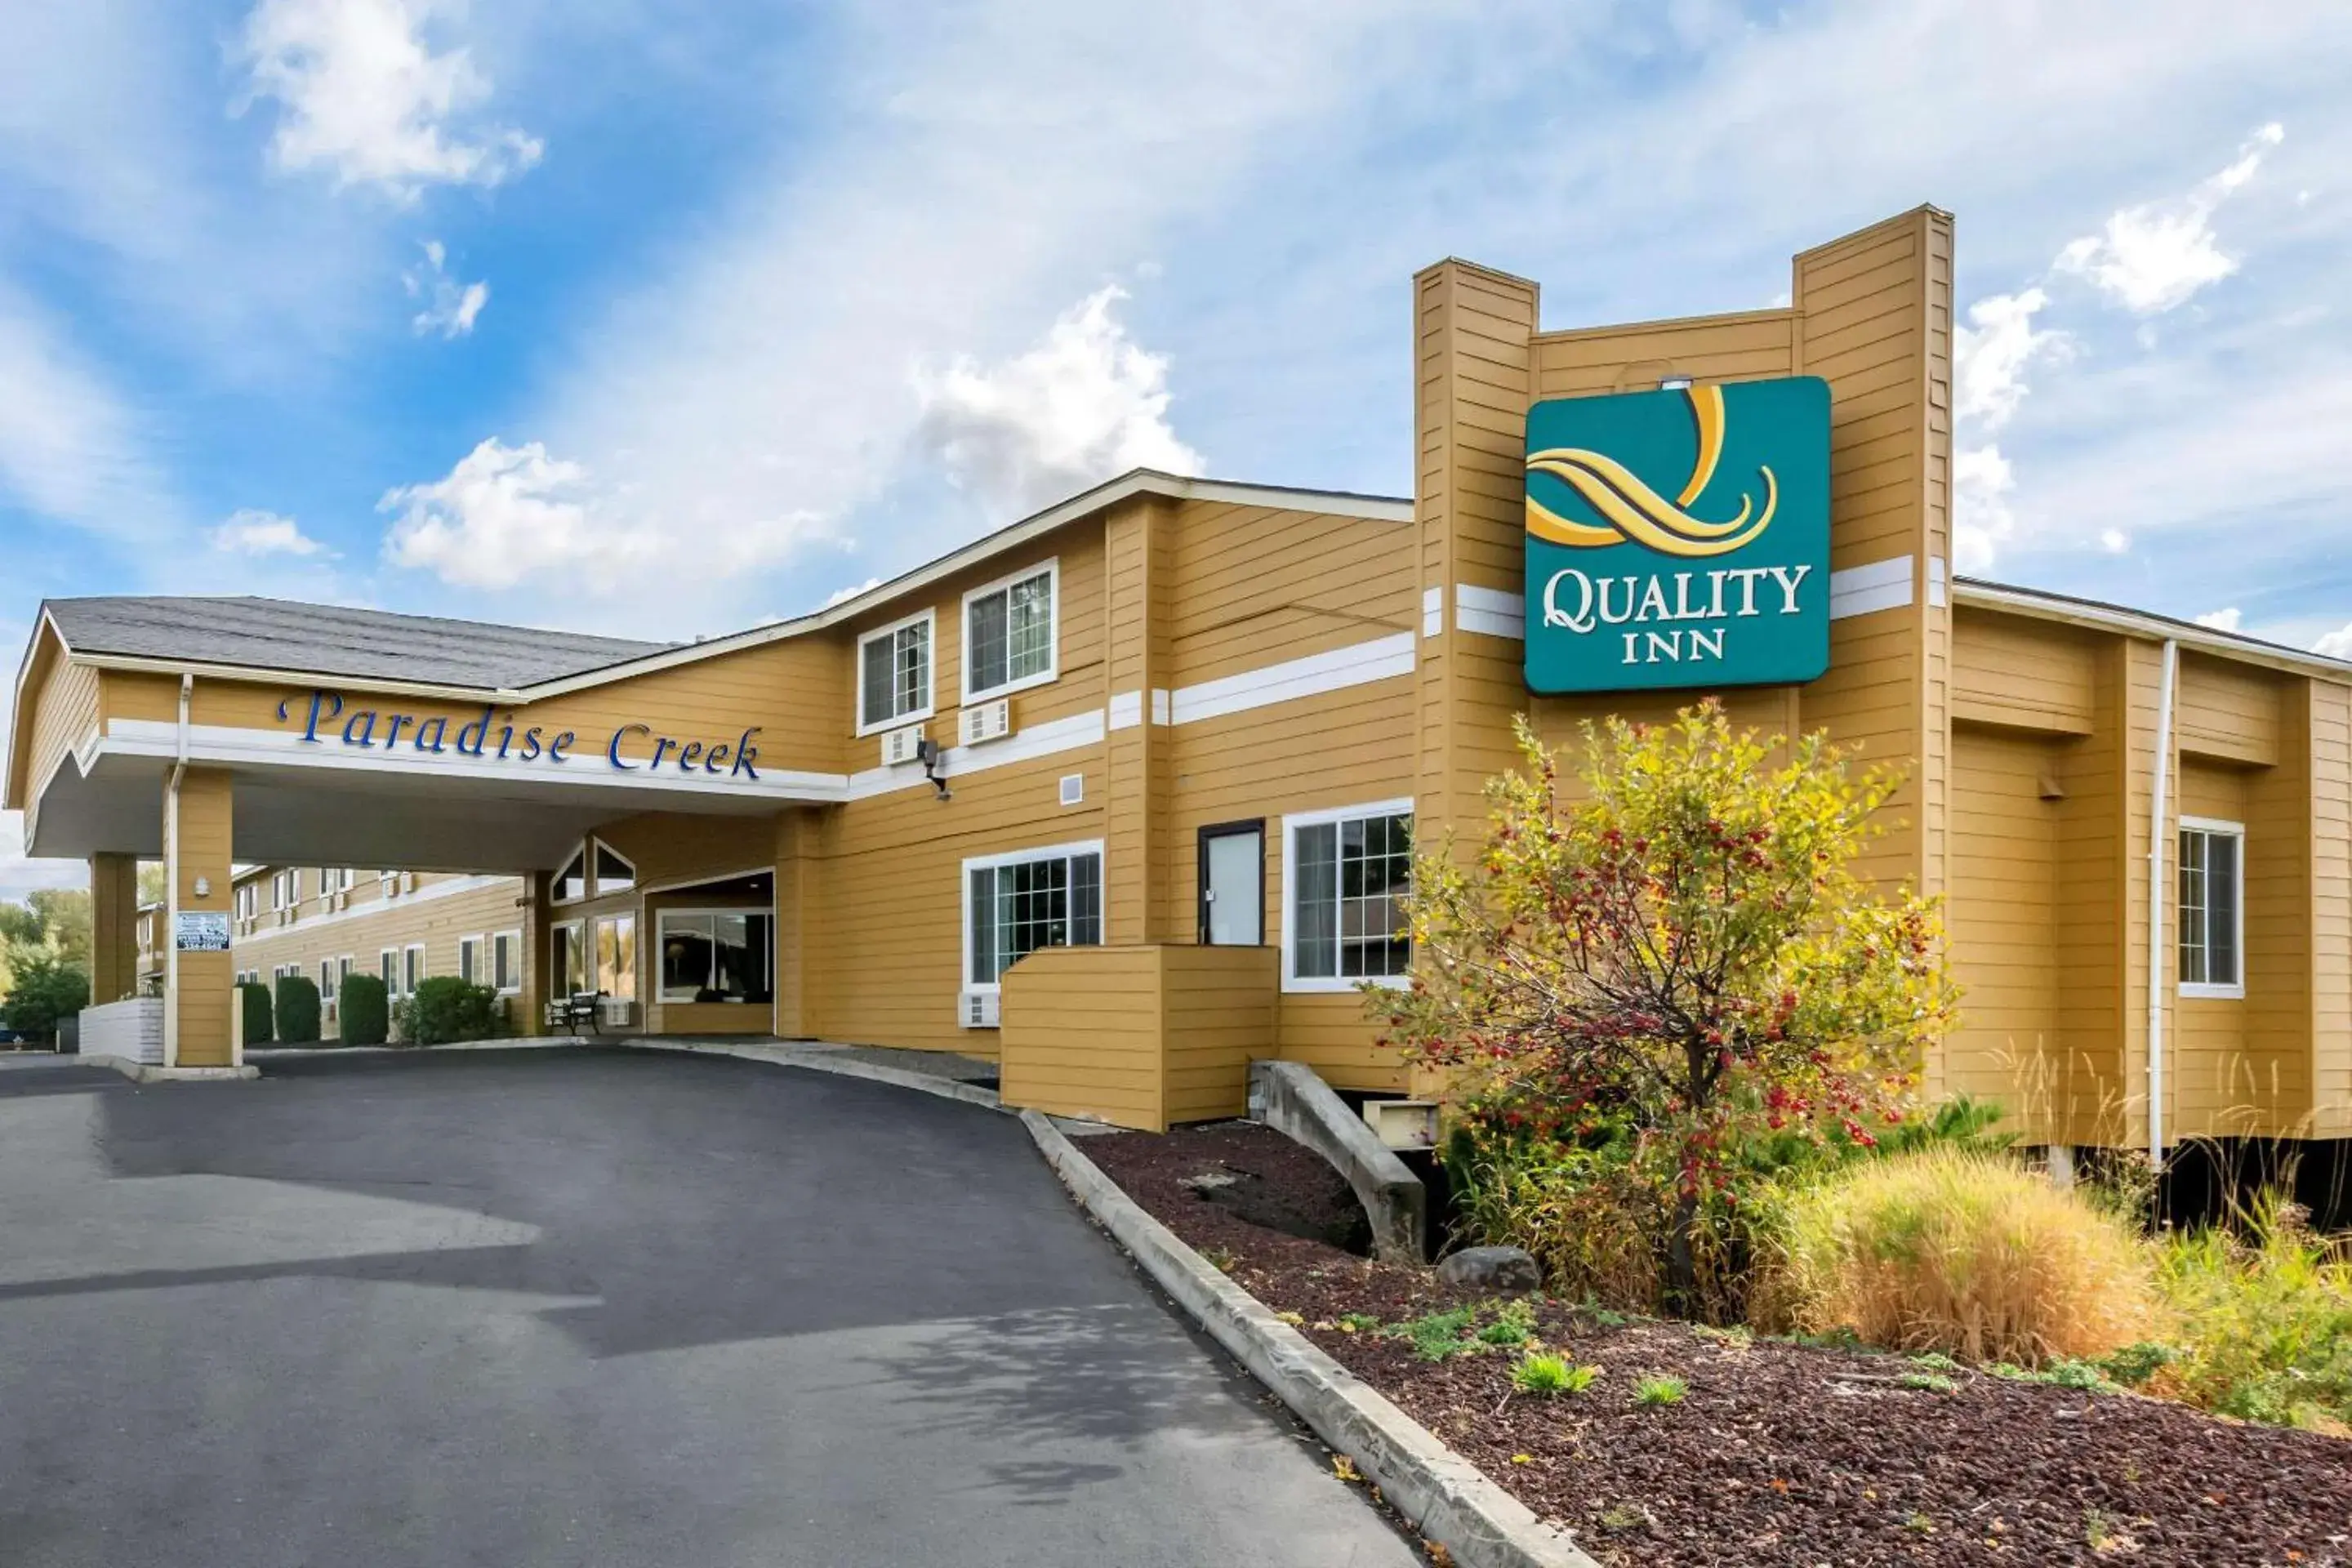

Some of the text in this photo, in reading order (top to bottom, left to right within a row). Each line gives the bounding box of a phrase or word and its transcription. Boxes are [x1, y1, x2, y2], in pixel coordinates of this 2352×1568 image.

[1543, 564, 1812, 634] QUALITY
[1622, 627, 1726, 664] INN
[278, 691, 763, 779] Paradise Creek
